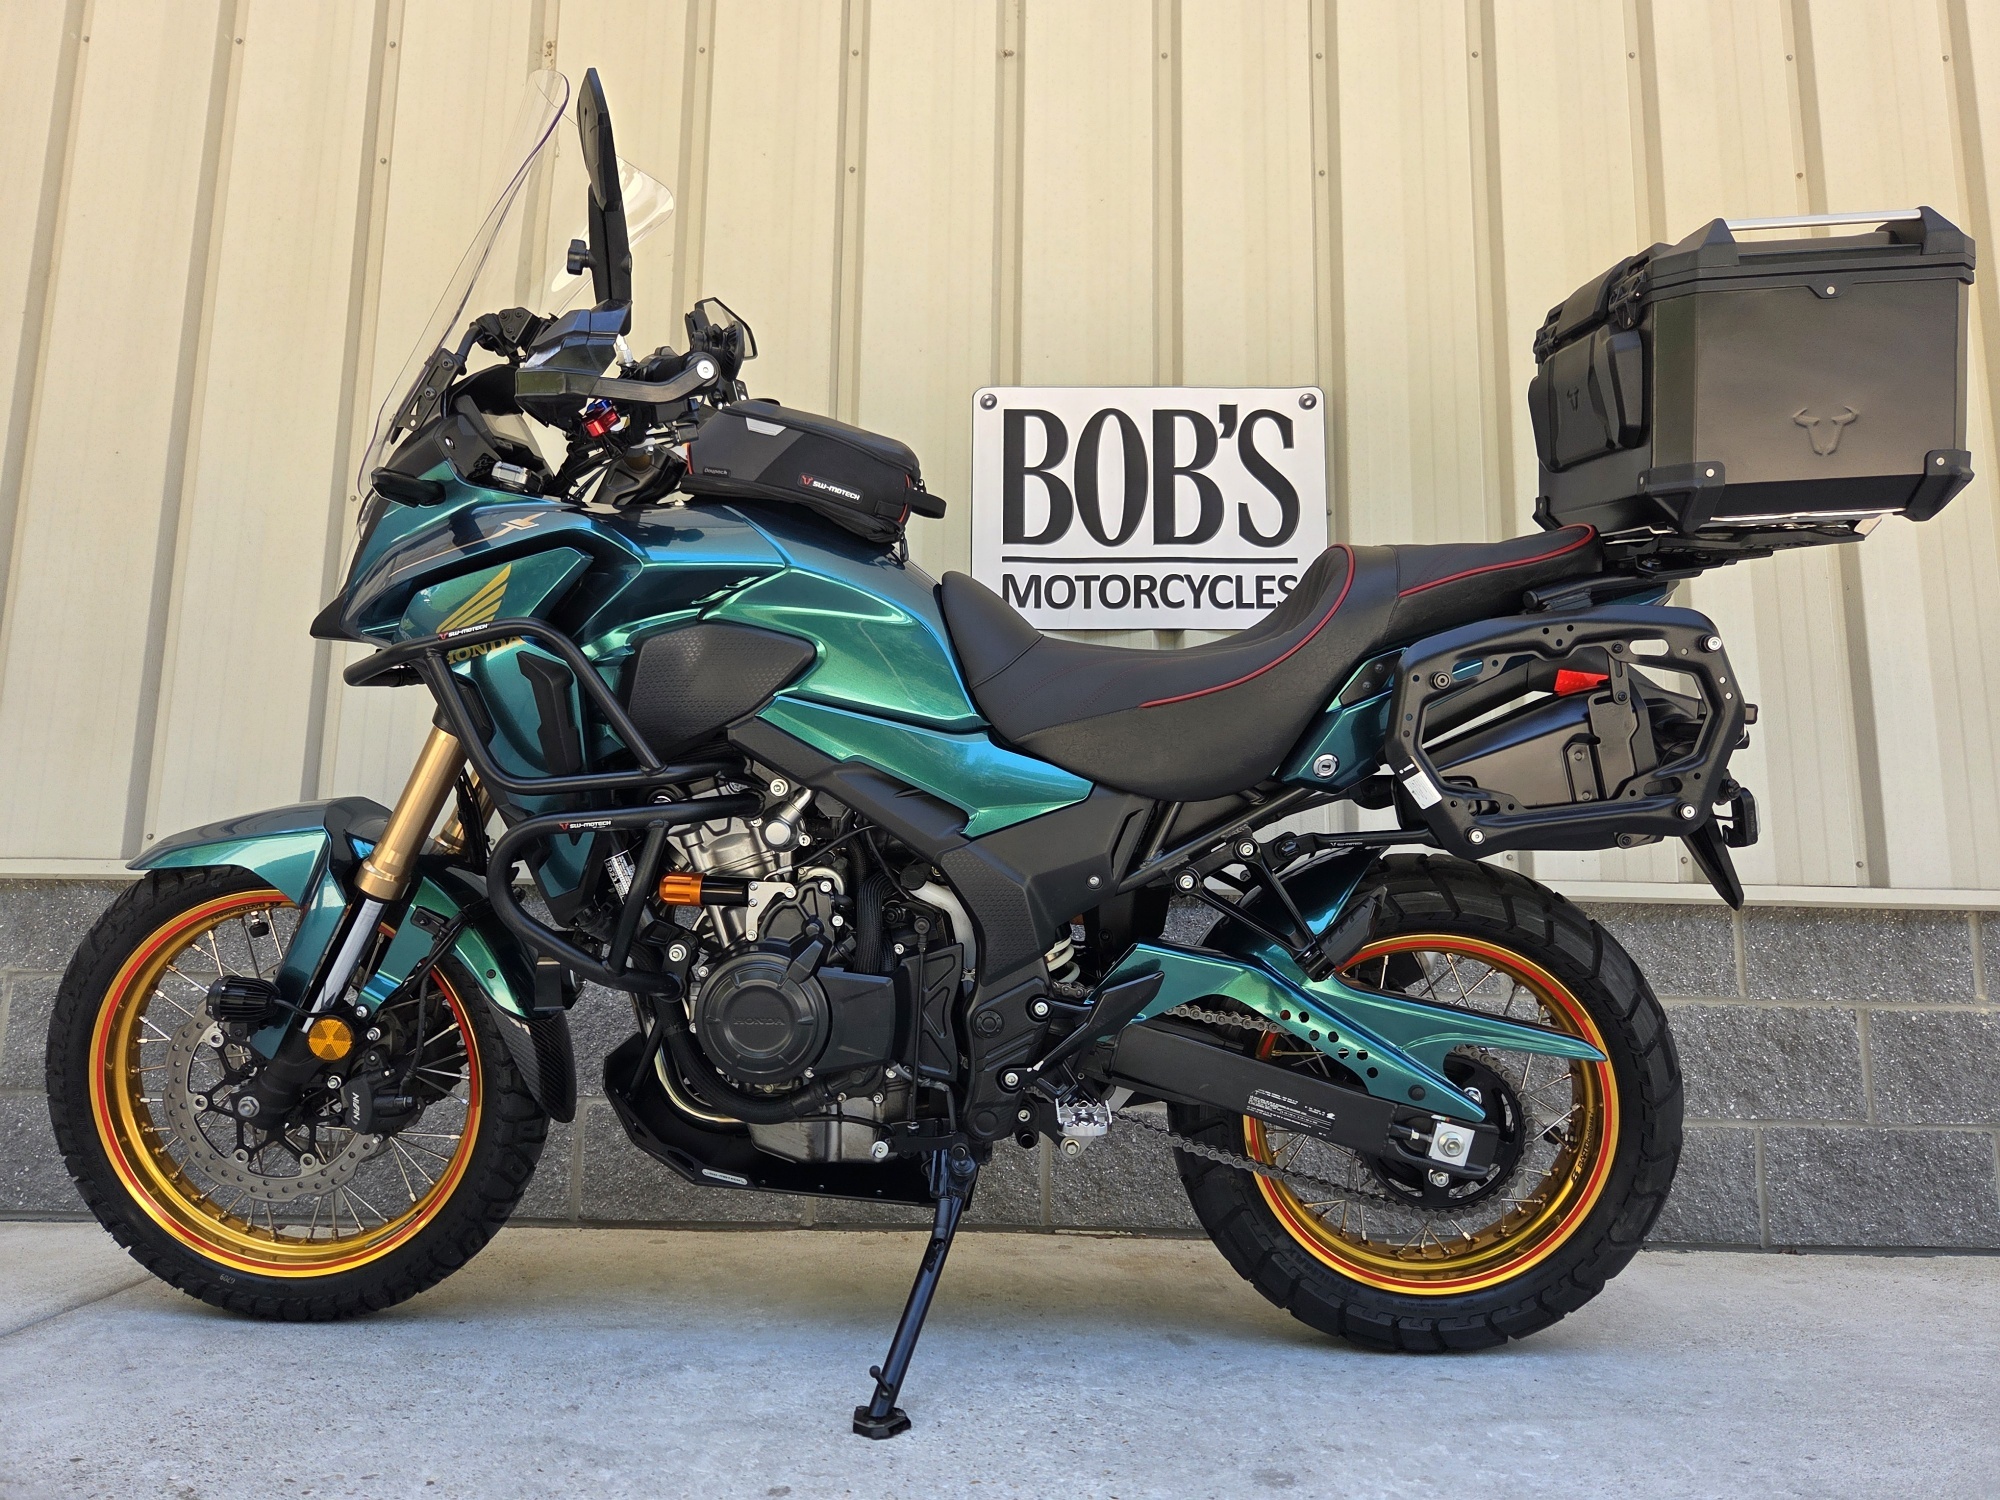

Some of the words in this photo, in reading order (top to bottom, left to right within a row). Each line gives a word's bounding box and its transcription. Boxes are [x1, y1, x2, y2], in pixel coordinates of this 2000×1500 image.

[1003, 404, 1300, 548] BOB'S
[812, 480, 861, 501] SW-MOTECH
[1002, 573, 1298, 611] MOTORCYCLES
[448, 623, 489, 638] SW-MOTECH
[569, 821, 611, 829] SW-MOTECH
[733, 1017, 786, 1026] HONDA
